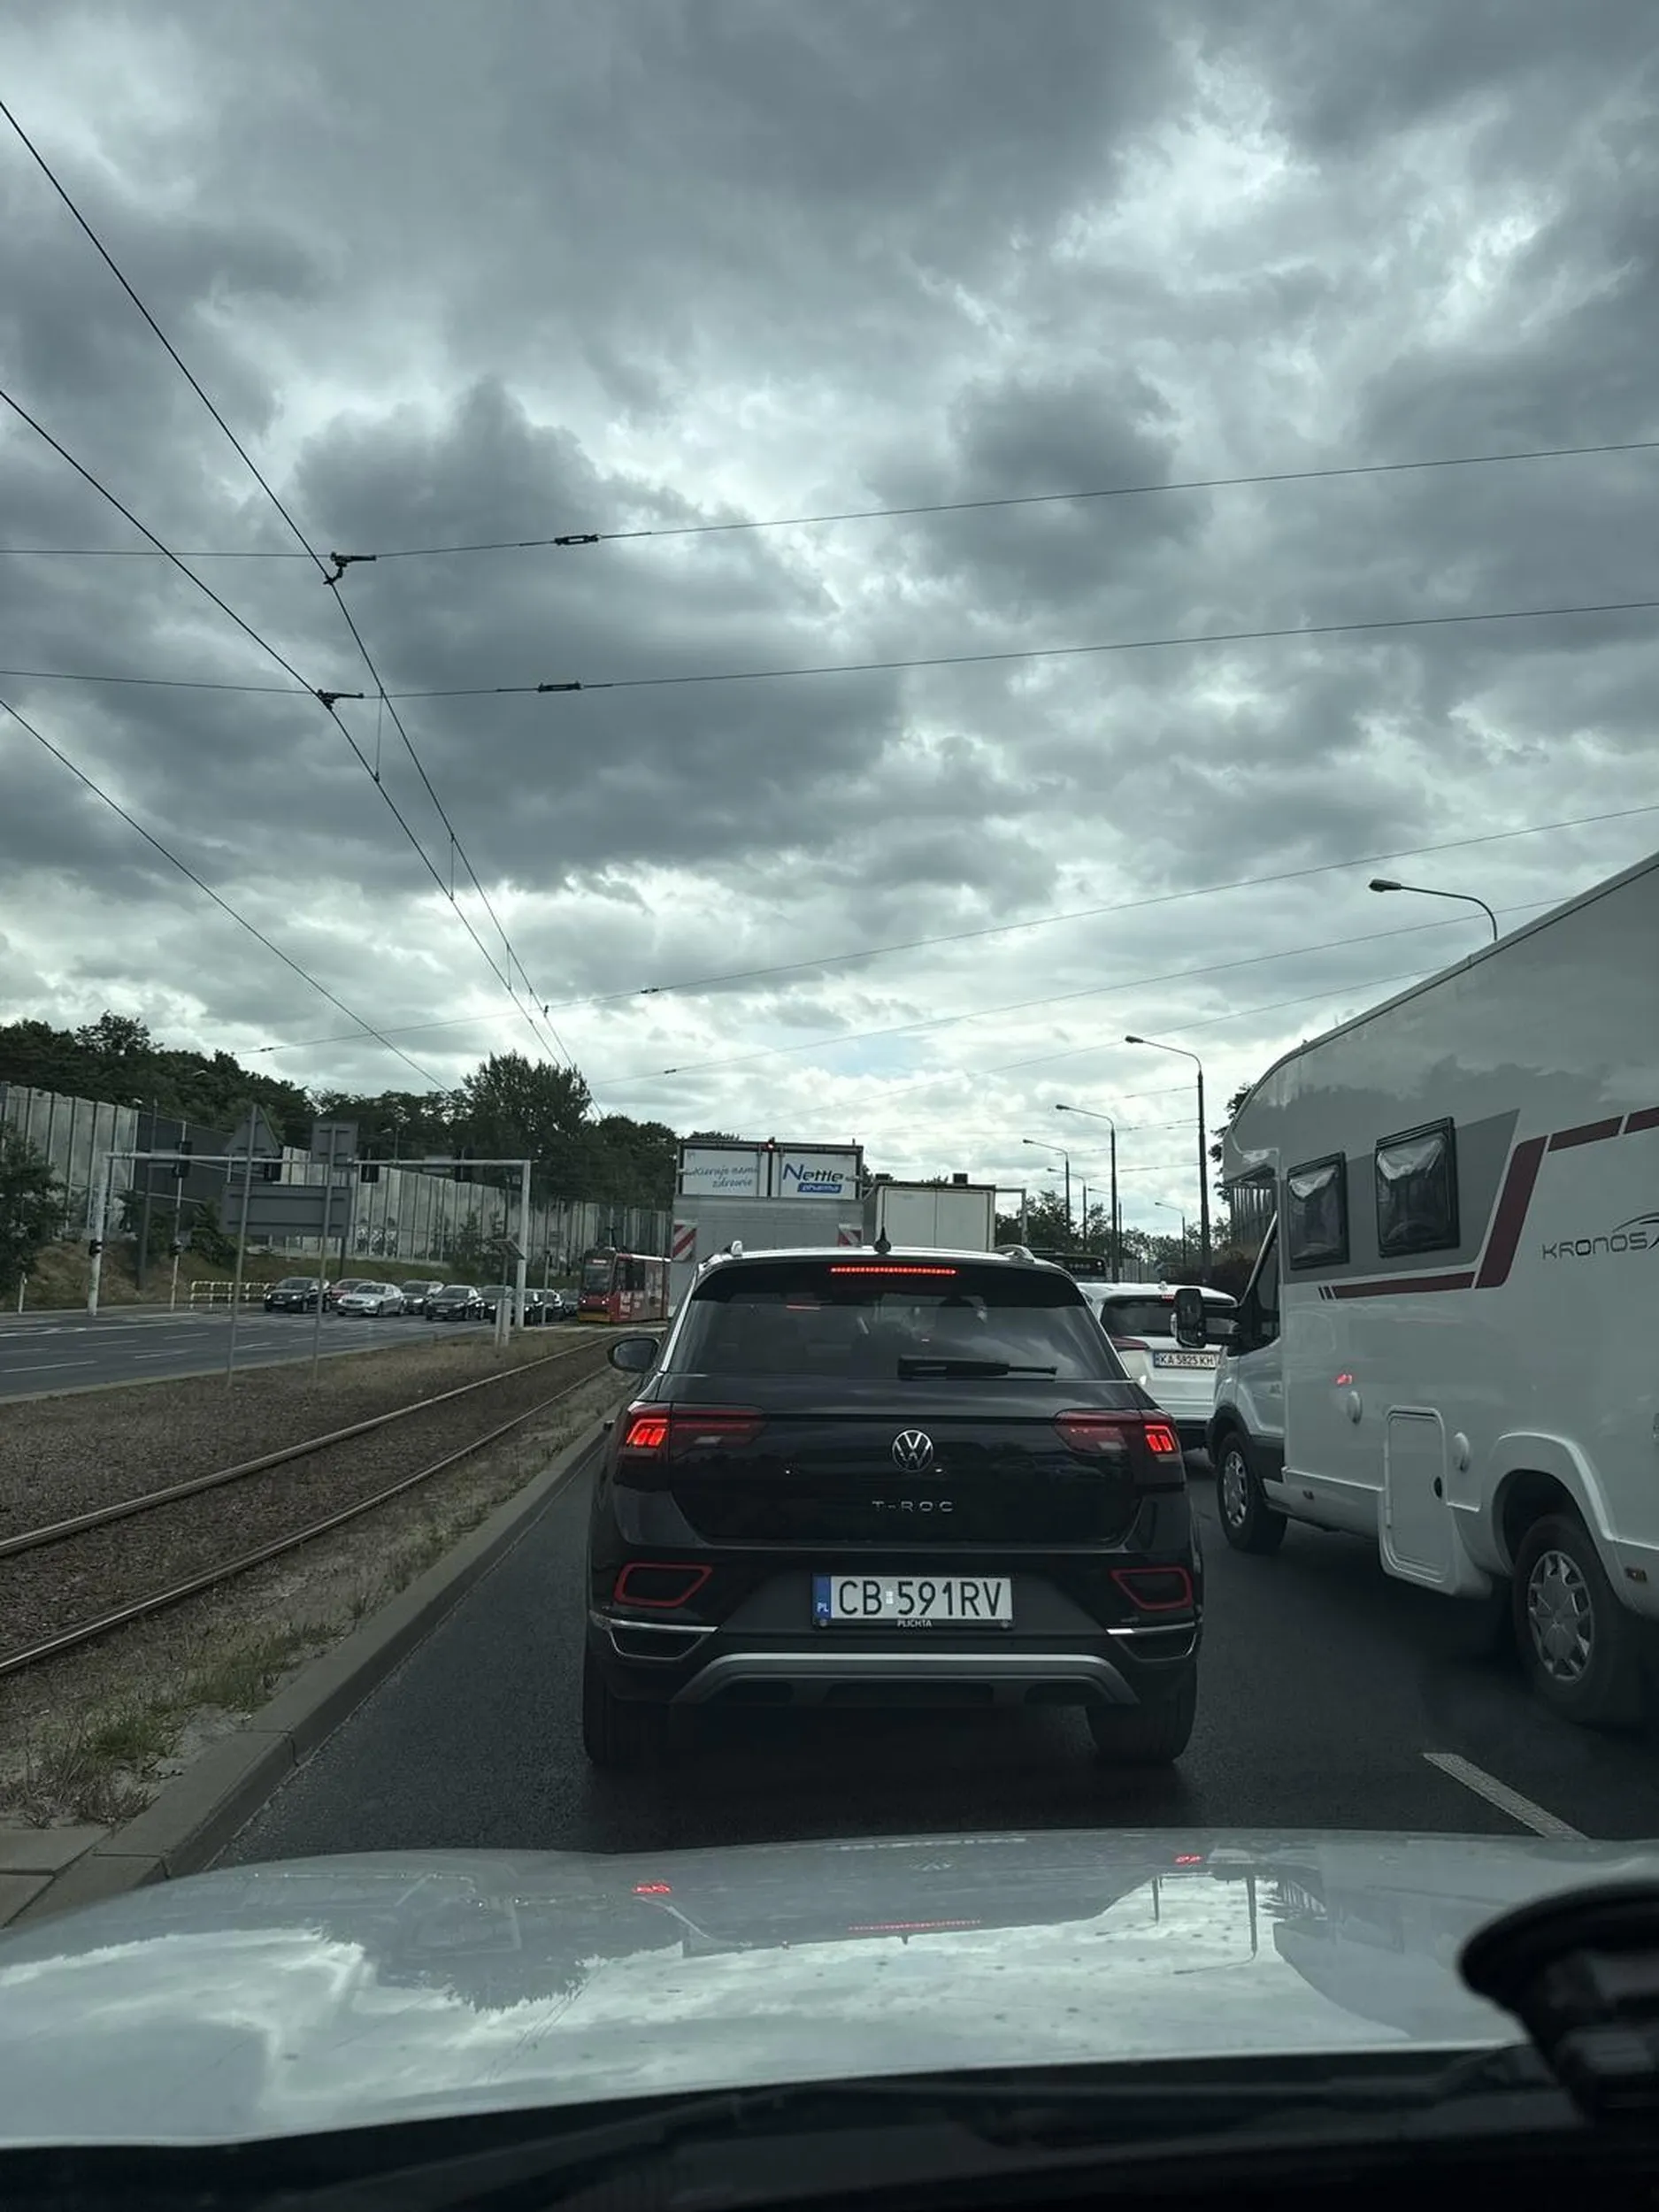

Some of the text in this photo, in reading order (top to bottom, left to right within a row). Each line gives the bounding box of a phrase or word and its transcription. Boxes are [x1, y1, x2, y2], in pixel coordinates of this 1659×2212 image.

[783, 1164, 844, 1183] Nettle
[1159, 1353, 1174, 1364] KA
[872, 1501, 954, 1512] T-ROC
[839, 1580, 1002, 1617] CB 591RV
[818, 1602, 829, 1612] PL
[897, 1619, 933, 1629] PLICHTA
